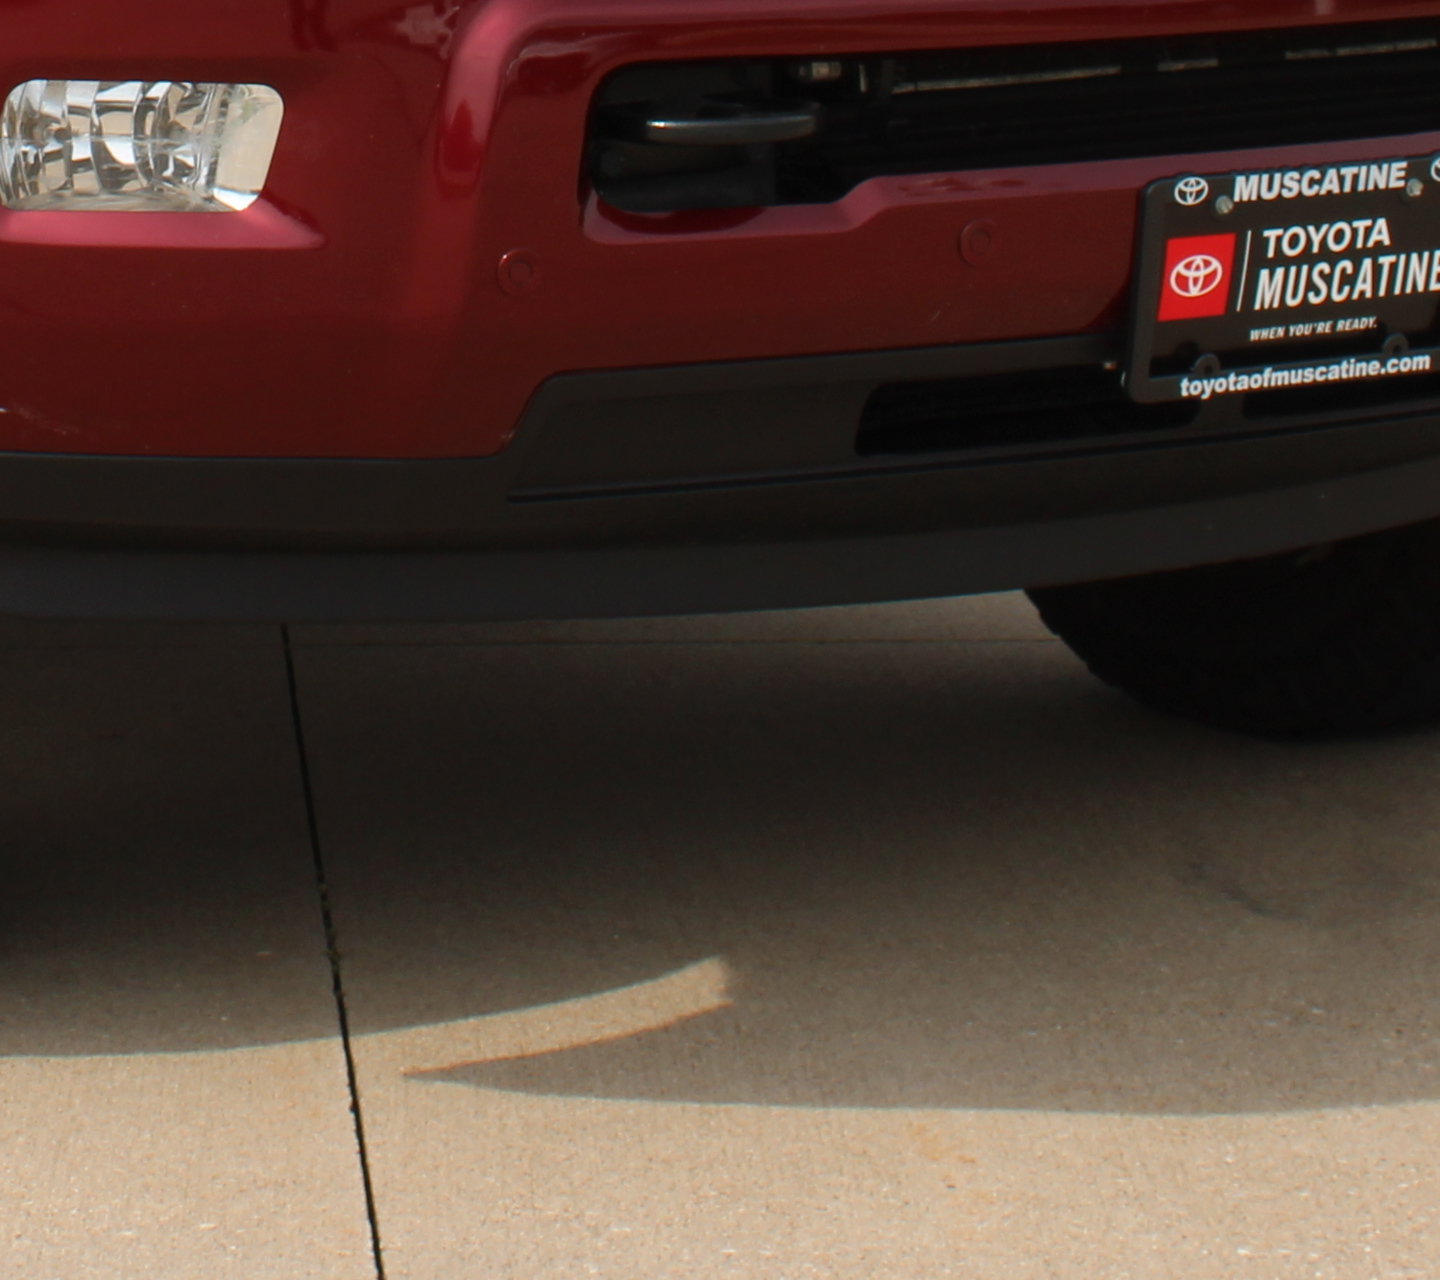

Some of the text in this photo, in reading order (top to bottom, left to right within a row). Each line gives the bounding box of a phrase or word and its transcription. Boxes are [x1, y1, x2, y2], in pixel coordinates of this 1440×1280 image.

[1233, 161, 1409, 203] MUSCATINE
[1262, 217, 1392, 259] TOYOTA
[1249, 315, 1378, 342] WHEN YOU'RE READY.
[1180, 353, 1431, 400] toyotaofmuscatine.com
